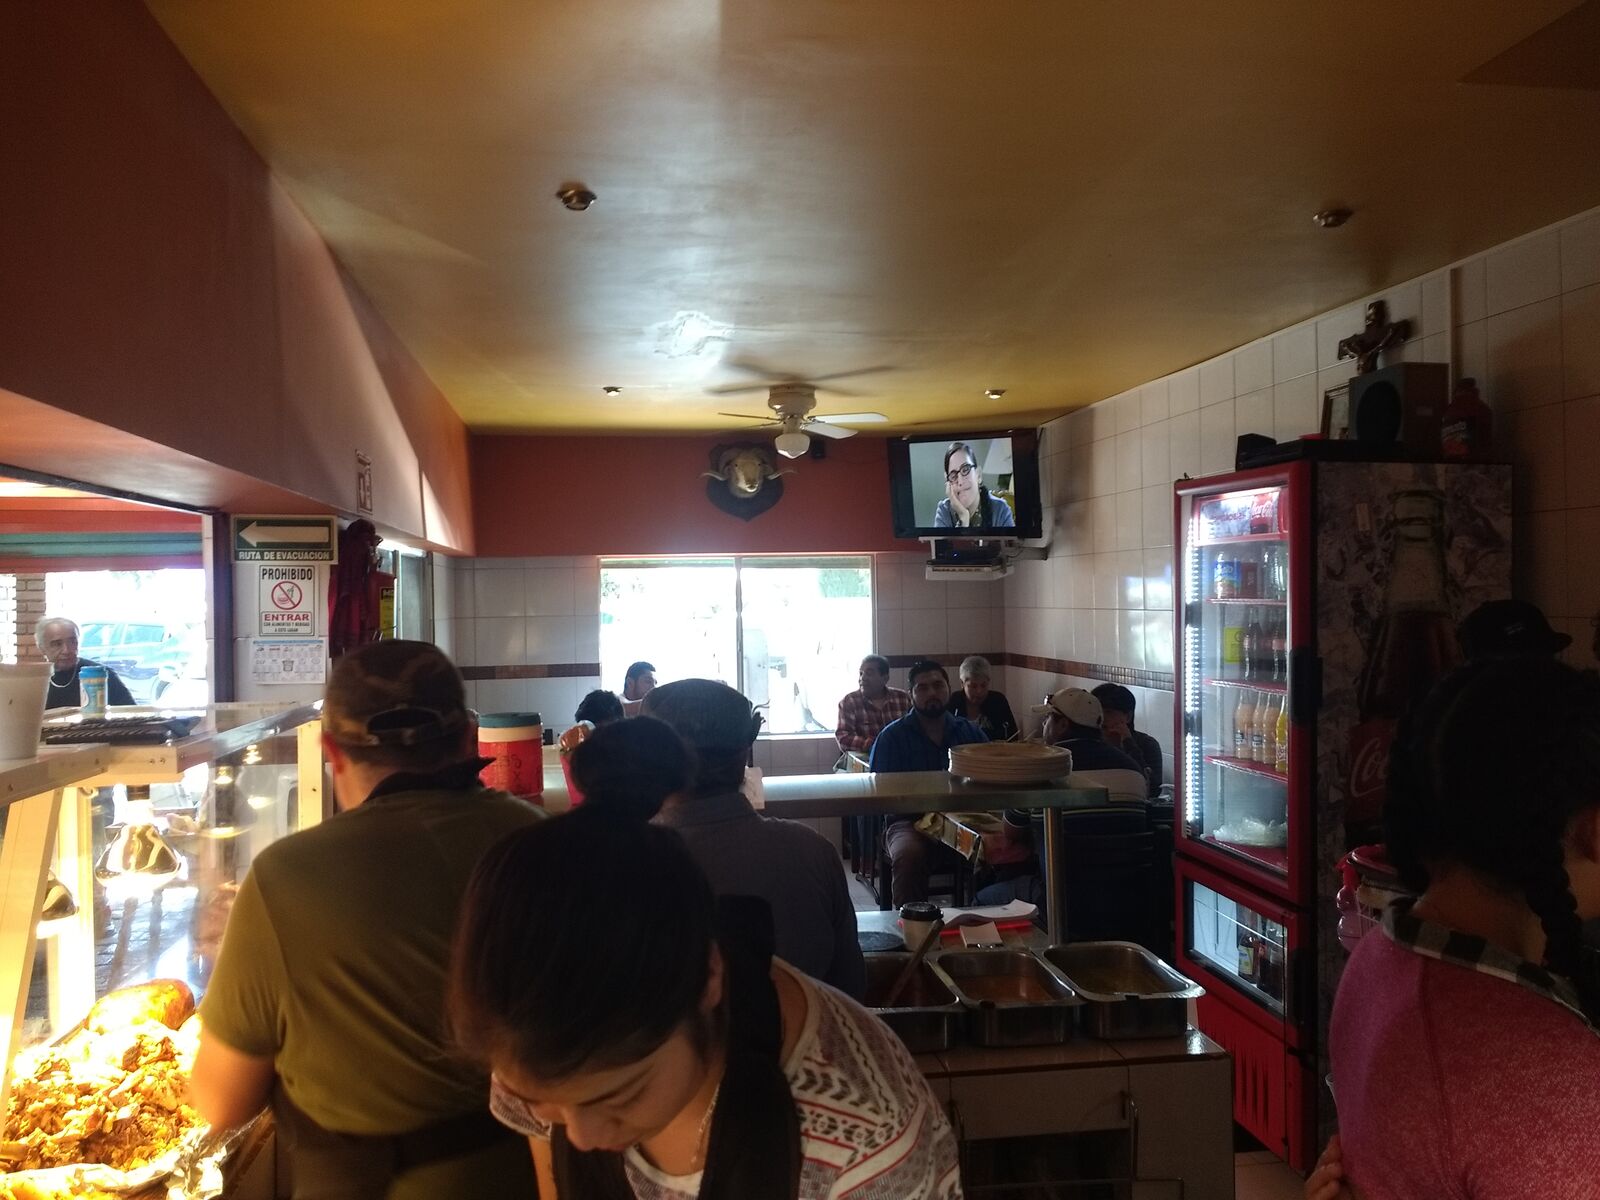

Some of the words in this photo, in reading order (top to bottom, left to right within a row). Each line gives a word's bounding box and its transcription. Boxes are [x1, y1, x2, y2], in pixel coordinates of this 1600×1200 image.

[239, 551, 261, 560] RUTA
[263, 551, 275, 560] DE
[261, 568, 313, 580] PROHIBIDO
[264, 613, 310, 622] ENTRAR
